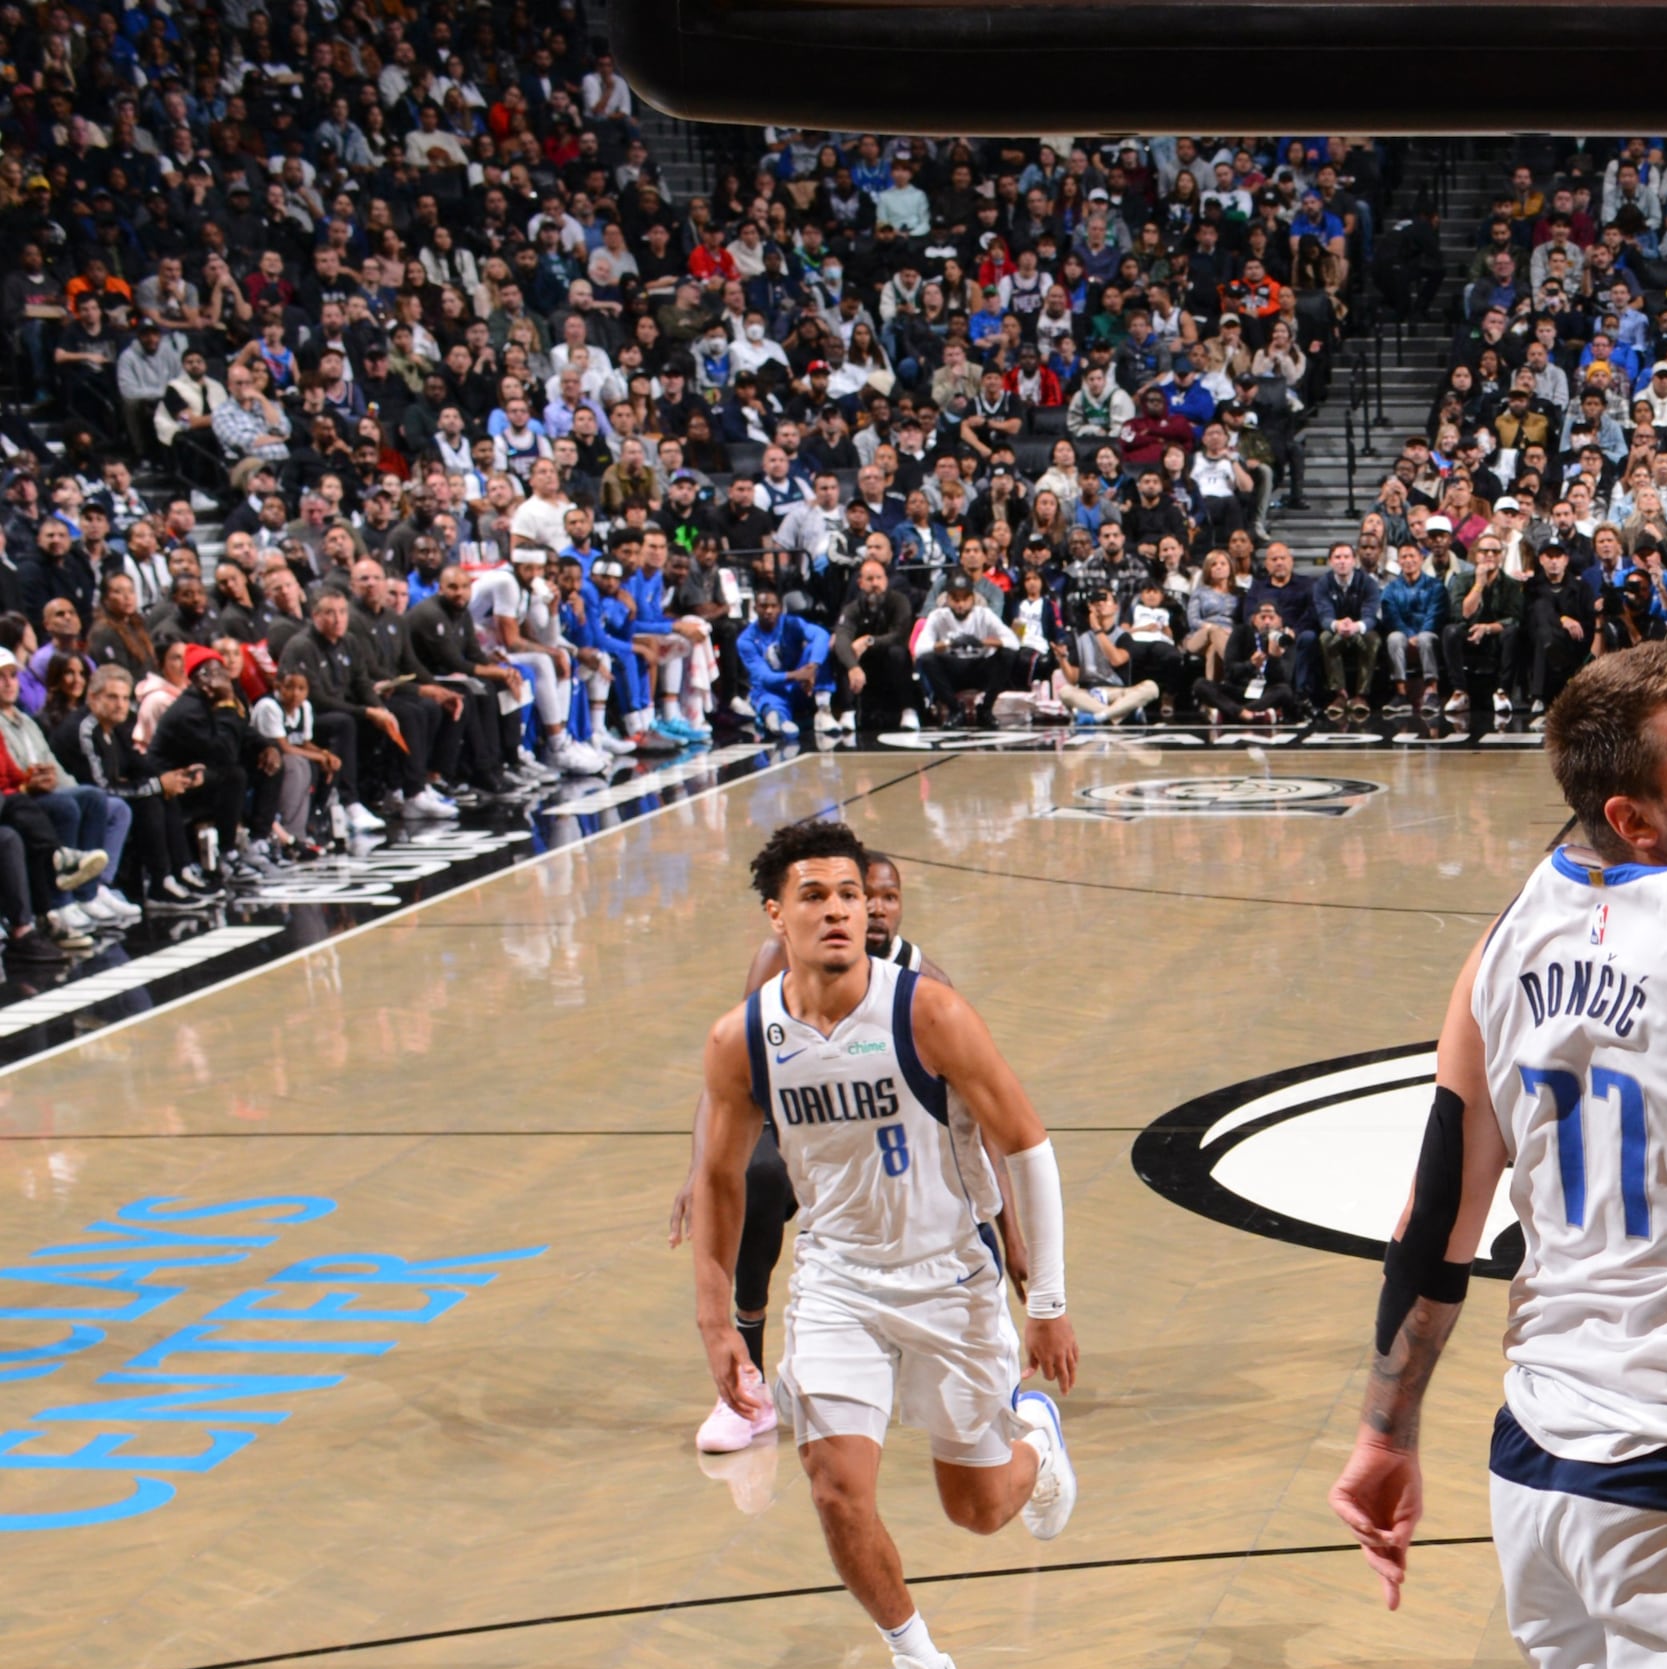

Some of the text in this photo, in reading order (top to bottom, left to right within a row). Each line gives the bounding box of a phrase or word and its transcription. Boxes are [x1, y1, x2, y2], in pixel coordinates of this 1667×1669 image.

[1062, 732, 1547, 745] FANDUE
[1519, 952, 1649, 1038] DONČIĆ
[848, 1040, 887, 1055] chime
[779, 1077, 899, 1126] DALLAS
[876, 1123, 910, 1179] 8
[1519, 1064, 1652, 1242] 77
[0, 1244, 550, 1532] CENTER
